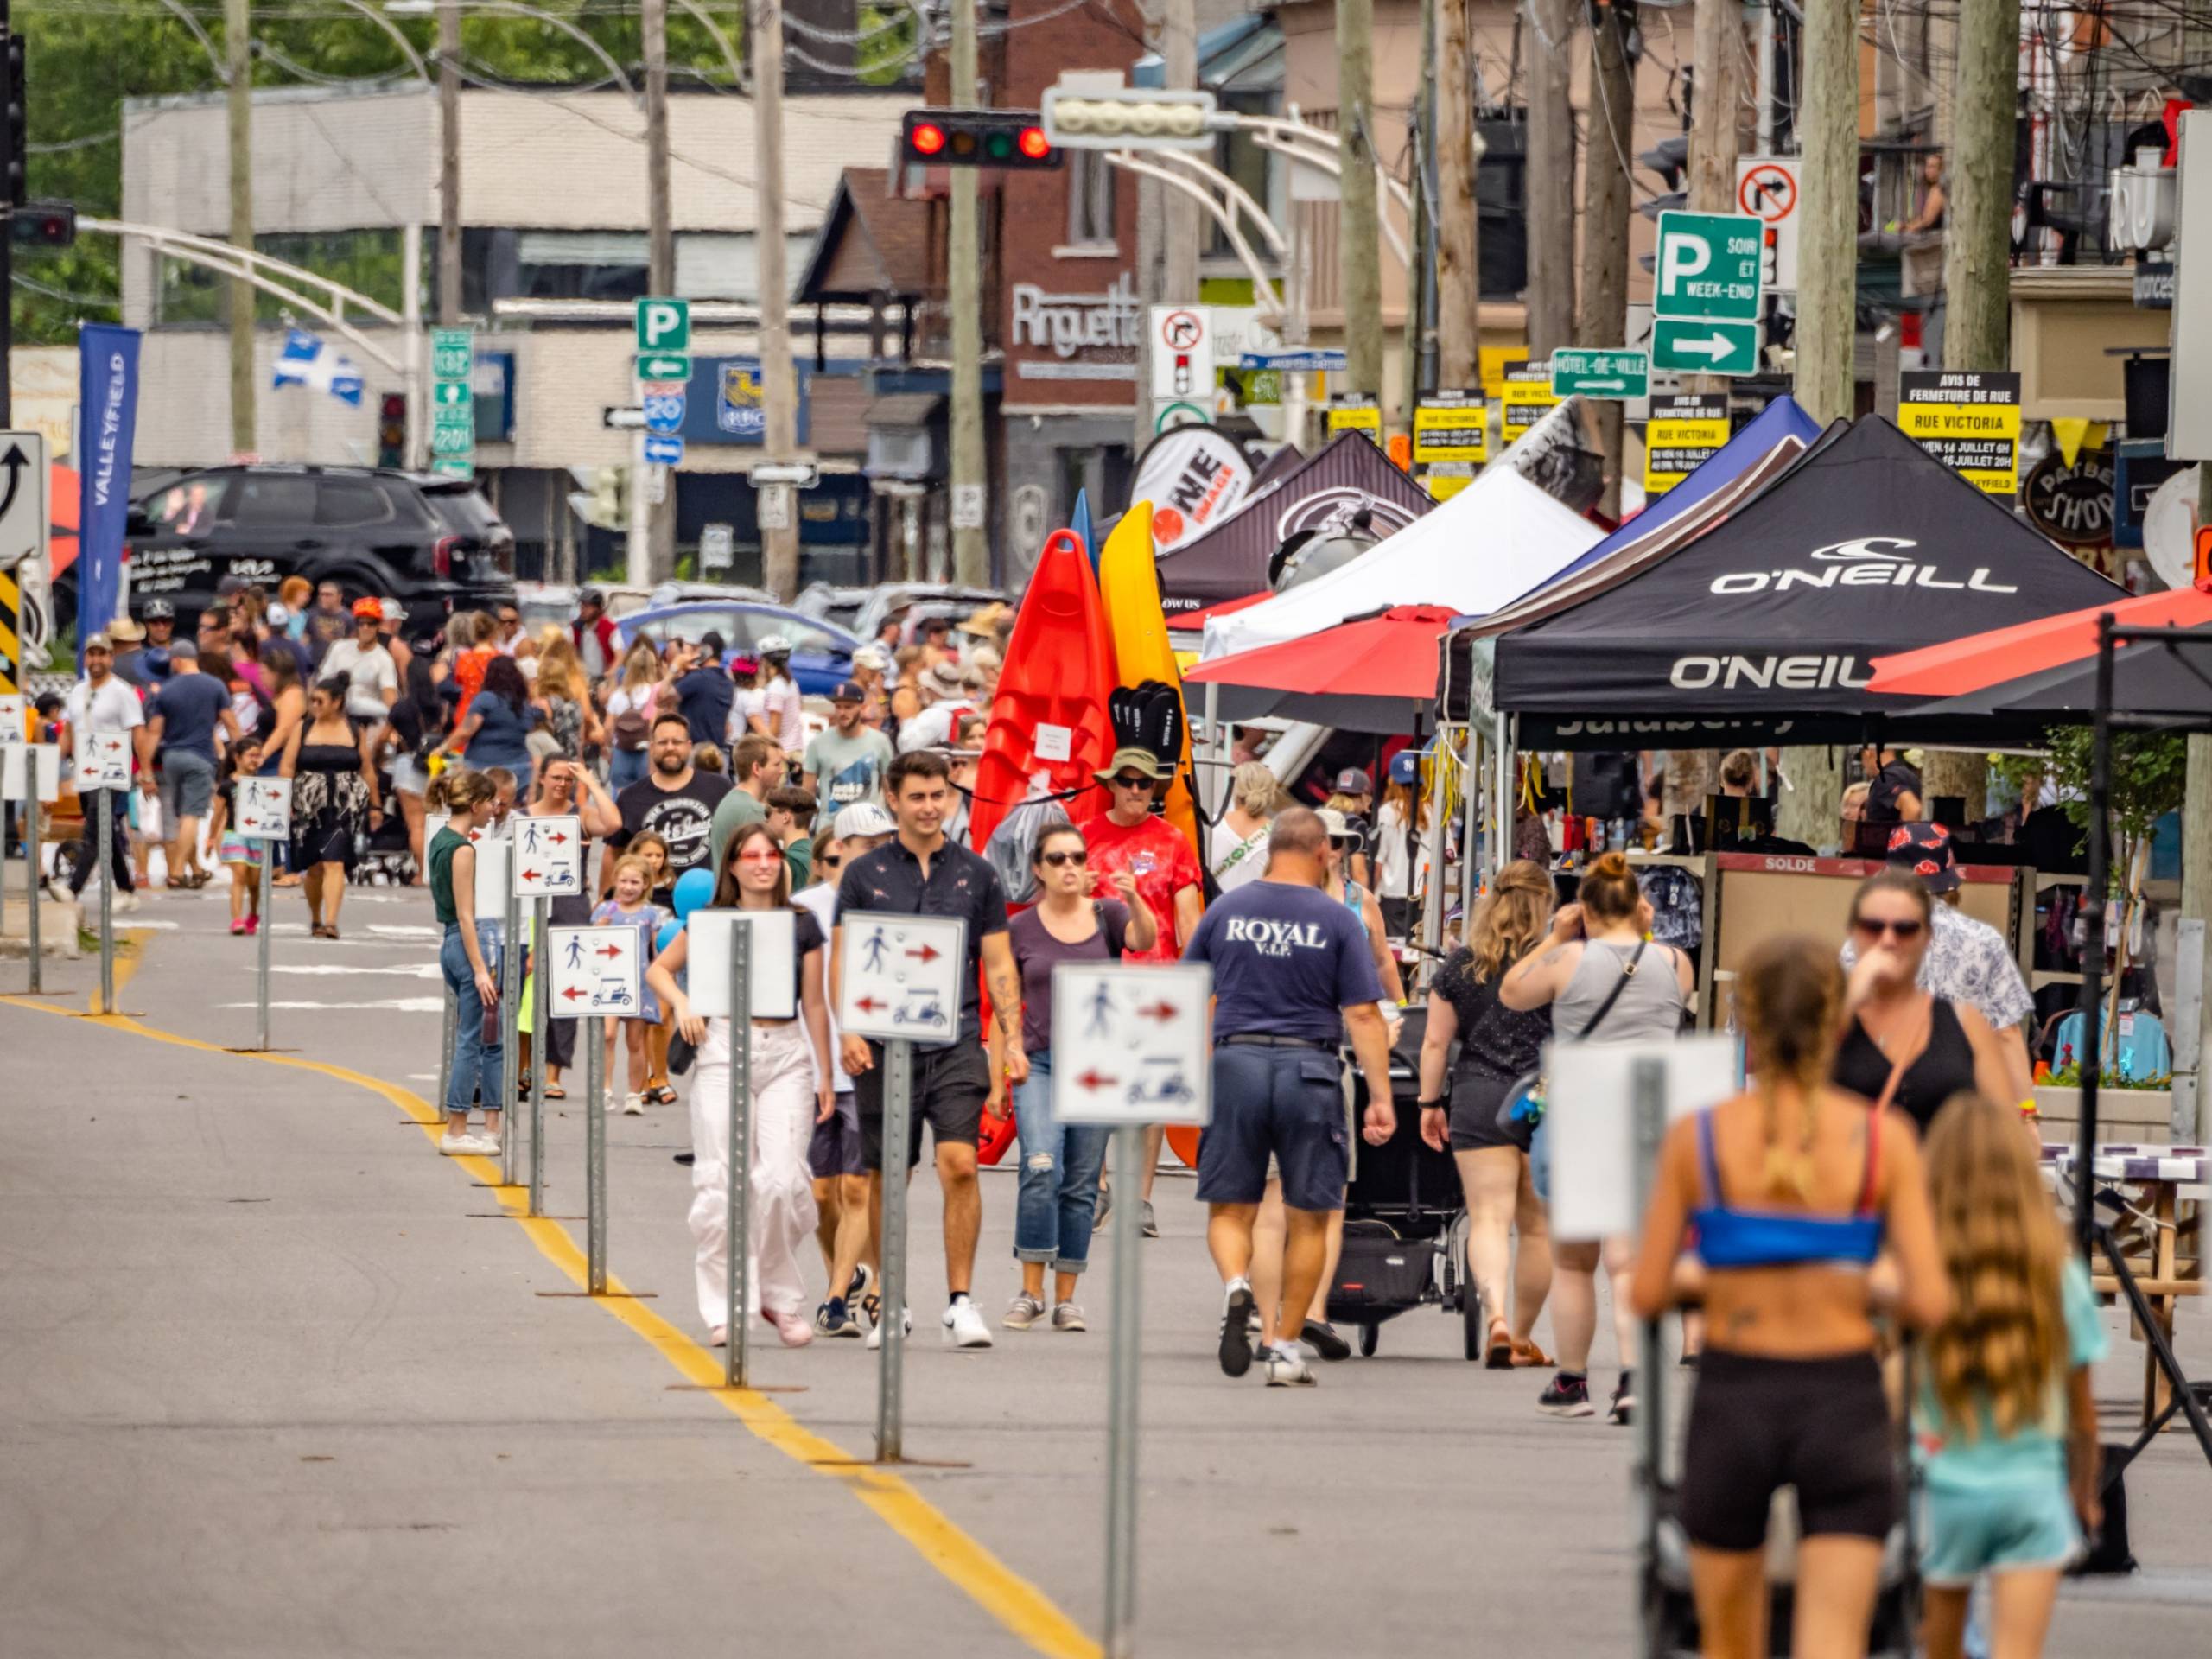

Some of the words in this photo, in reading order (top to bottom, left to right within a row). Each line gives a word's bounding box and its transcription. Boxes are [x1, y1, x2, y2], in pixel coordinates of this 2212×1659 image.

[1727, 237, 1757, 255] SOIR
[1662, 232, 1711, 296] P
[1739, 261, 1755, 277] ET
[1687, 282, 1755, 299] WEEK-END
[645, 304, 680, 346] P
[1940, 374, 1964, 386] AVIS
[1967, 375, 1980, 386] DE
[1910, 389, 1971, 402] FERMETURE
[1973, 391, 1986, 402] DE
[1990, 391, 2012, 403] RUE
[648, 398, 681, 420] 20
[95, 353, 125, 506] VALLEYFIELD
[1915, 415, 1940, 429] RUE
[1944, 416, 2004, 429] VICTORIA
[1657, 430, 1674, 441] RUE
[1677, 429, 1717, 440] VICTORIA
[1958, 442, 1995, 454] JUILLET
[1955, 456, 1993, 467] JUILLET
[1994, 456, 2012, 467] 20H
[2044, 493, 2115, 530] SHOP
[1710, 563, 2018, 594] O'NEILL
[1161, 598, 1185, 609] OW
[1185, 599, 1201, 610] US
[1669, 655, 1873, 690] O'NEIL
[1765, 857, 1815, 872] SOLDE
[1225, 918, 1326, 949] ROYAL
